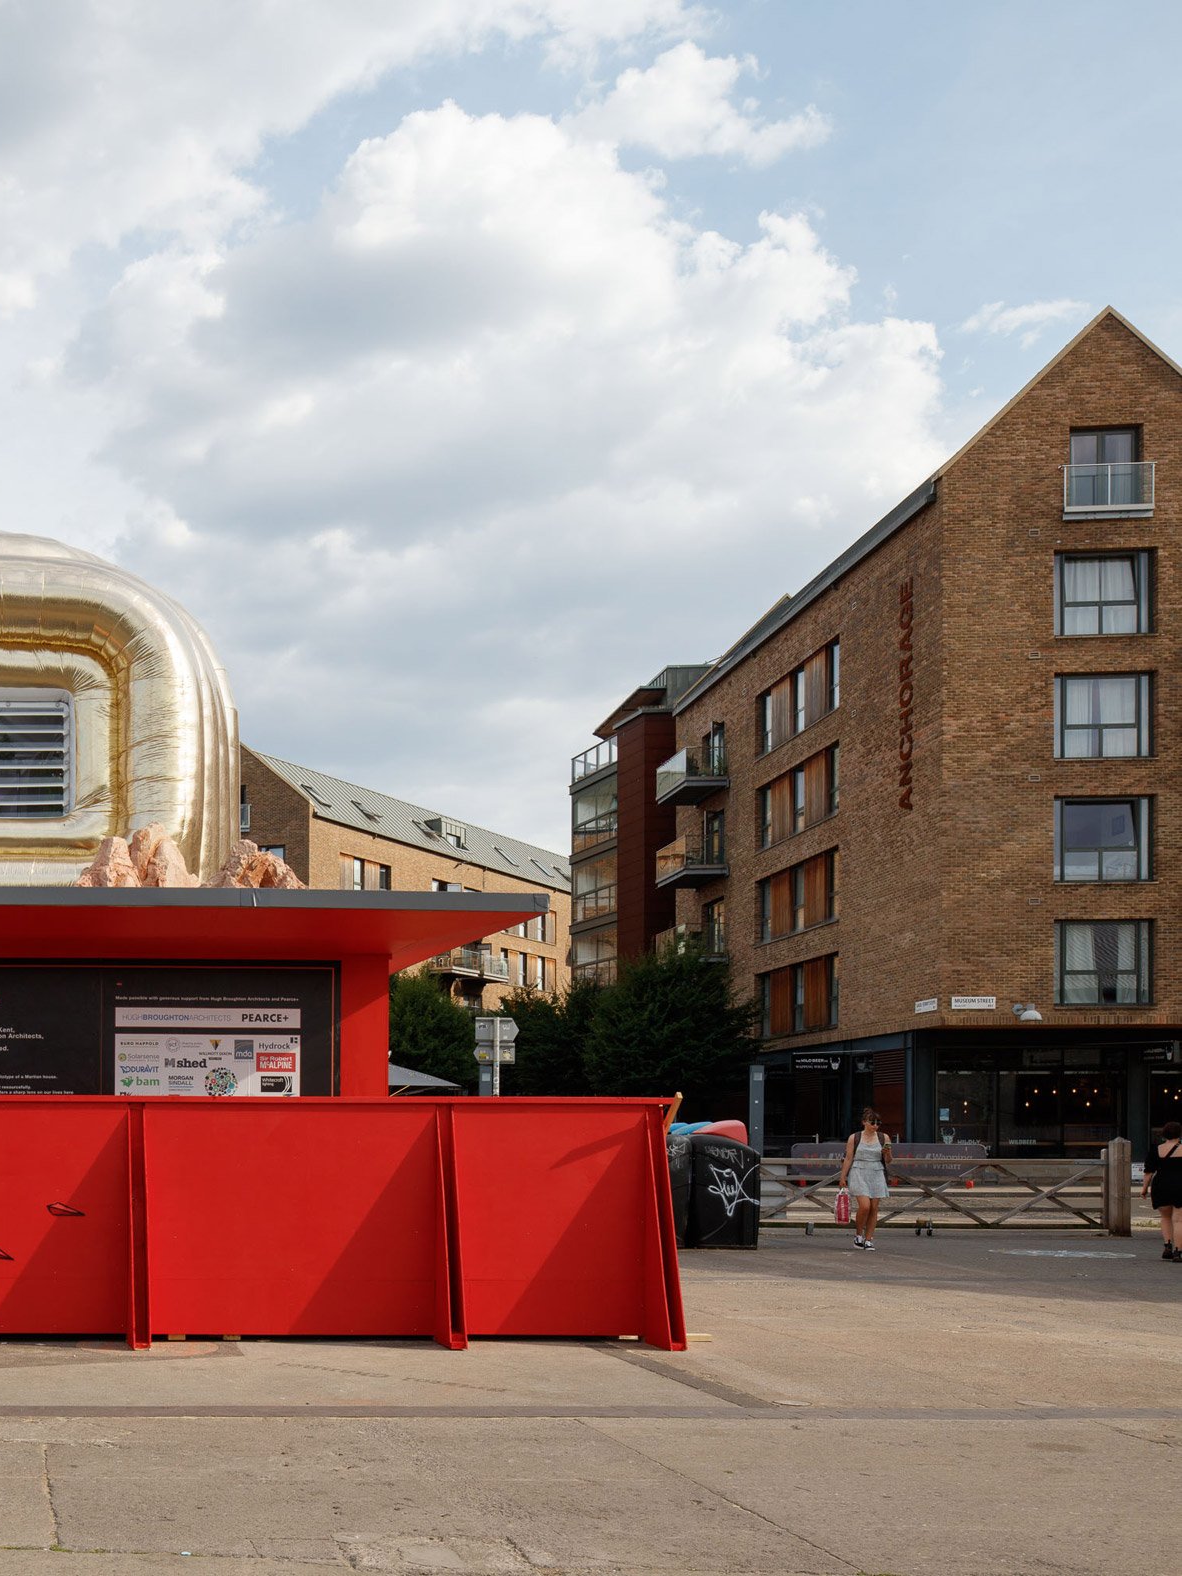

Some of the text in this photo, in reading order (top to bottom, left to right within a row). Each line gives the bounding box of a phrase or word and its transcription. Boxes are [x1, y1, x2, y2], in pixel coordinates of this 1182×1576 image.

[899, 577, 914, 810] ANCHORAGE
[241, 1013, 289, 1022] PEARCE+
[258, 1042, 290, 1051] Hydrock
[176, 1058, 207, 1068] shed
[136, 1076, 160, 1086] bam
